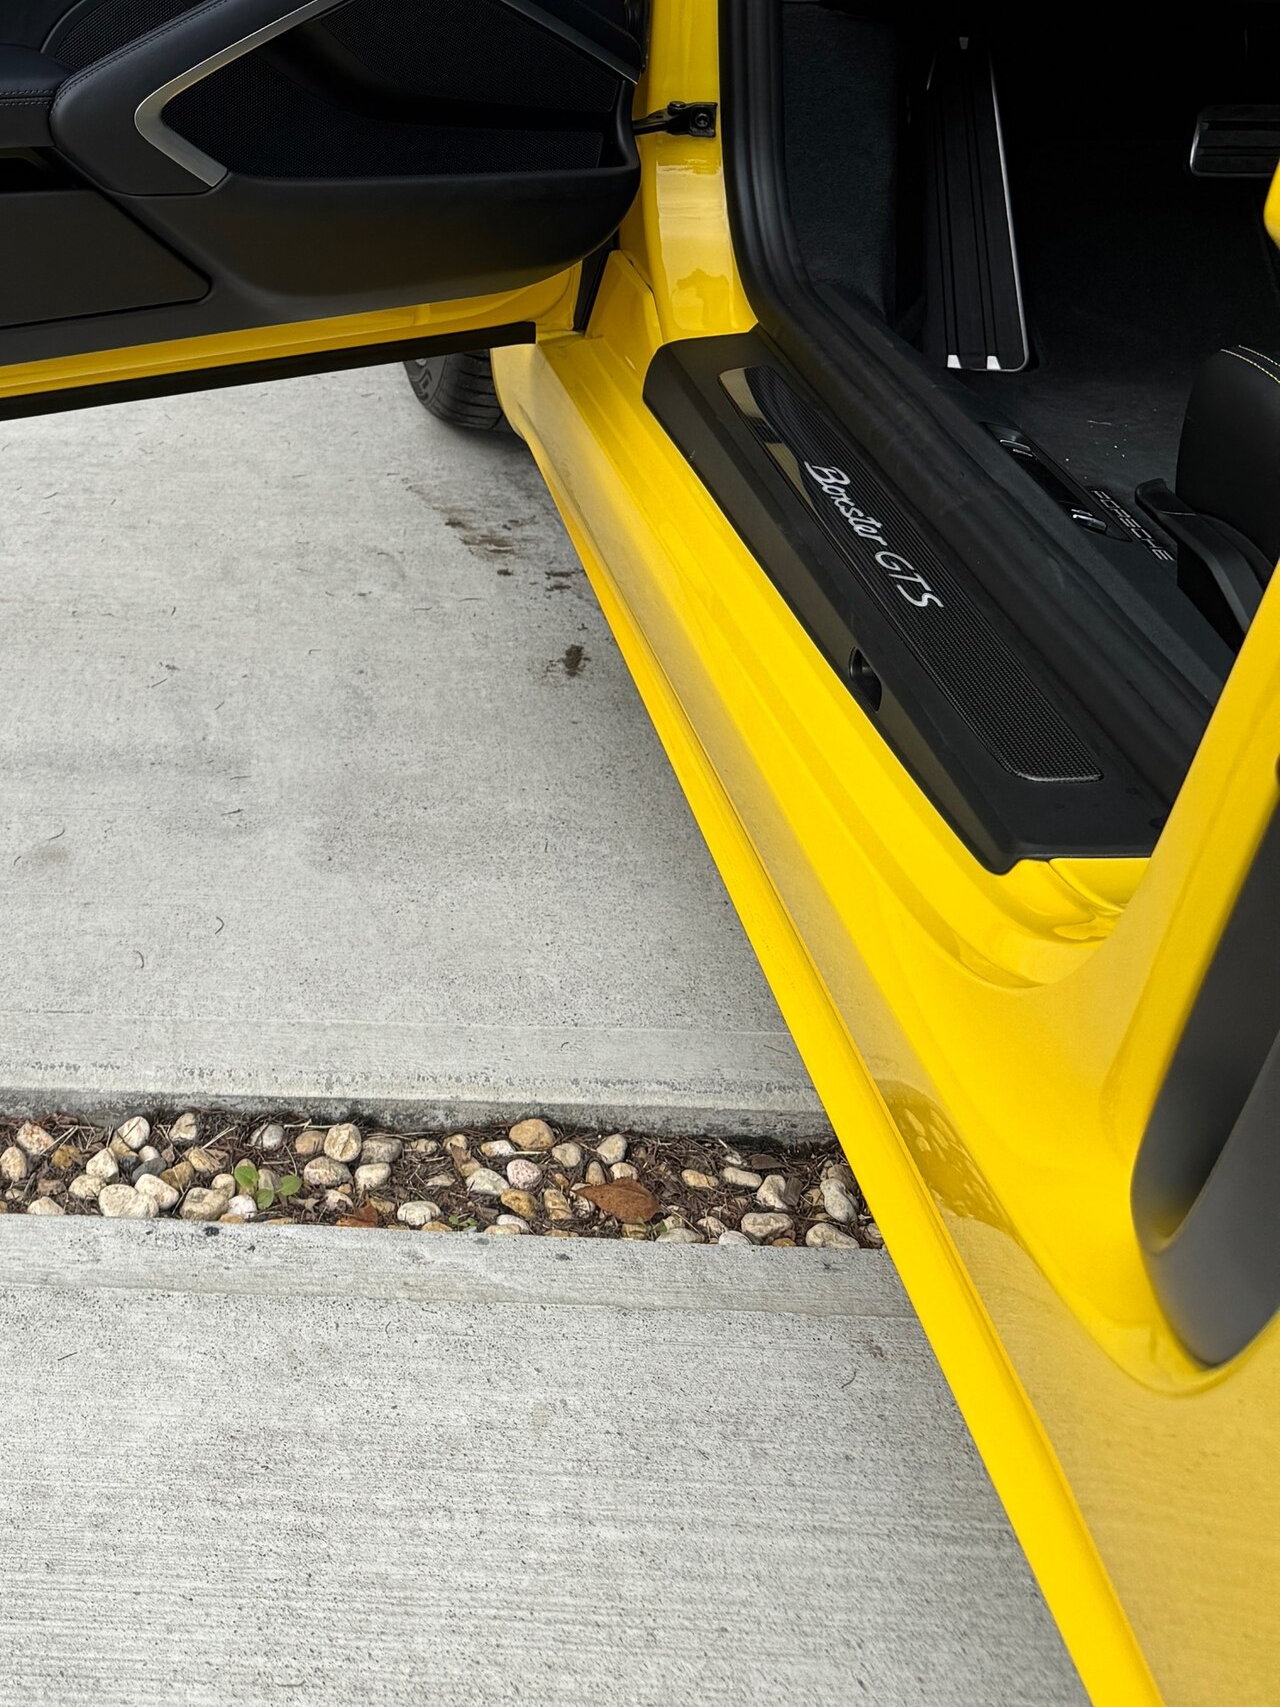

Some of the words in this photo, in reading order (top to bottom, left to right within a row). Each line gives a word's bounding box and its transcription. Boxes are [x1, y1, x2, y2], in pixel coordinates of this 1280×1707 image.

[804, 460, 888, 546] Boxster
[874, 551, 944, 607] GTS
[1090, 490, 1175, 561] PORSCHE
